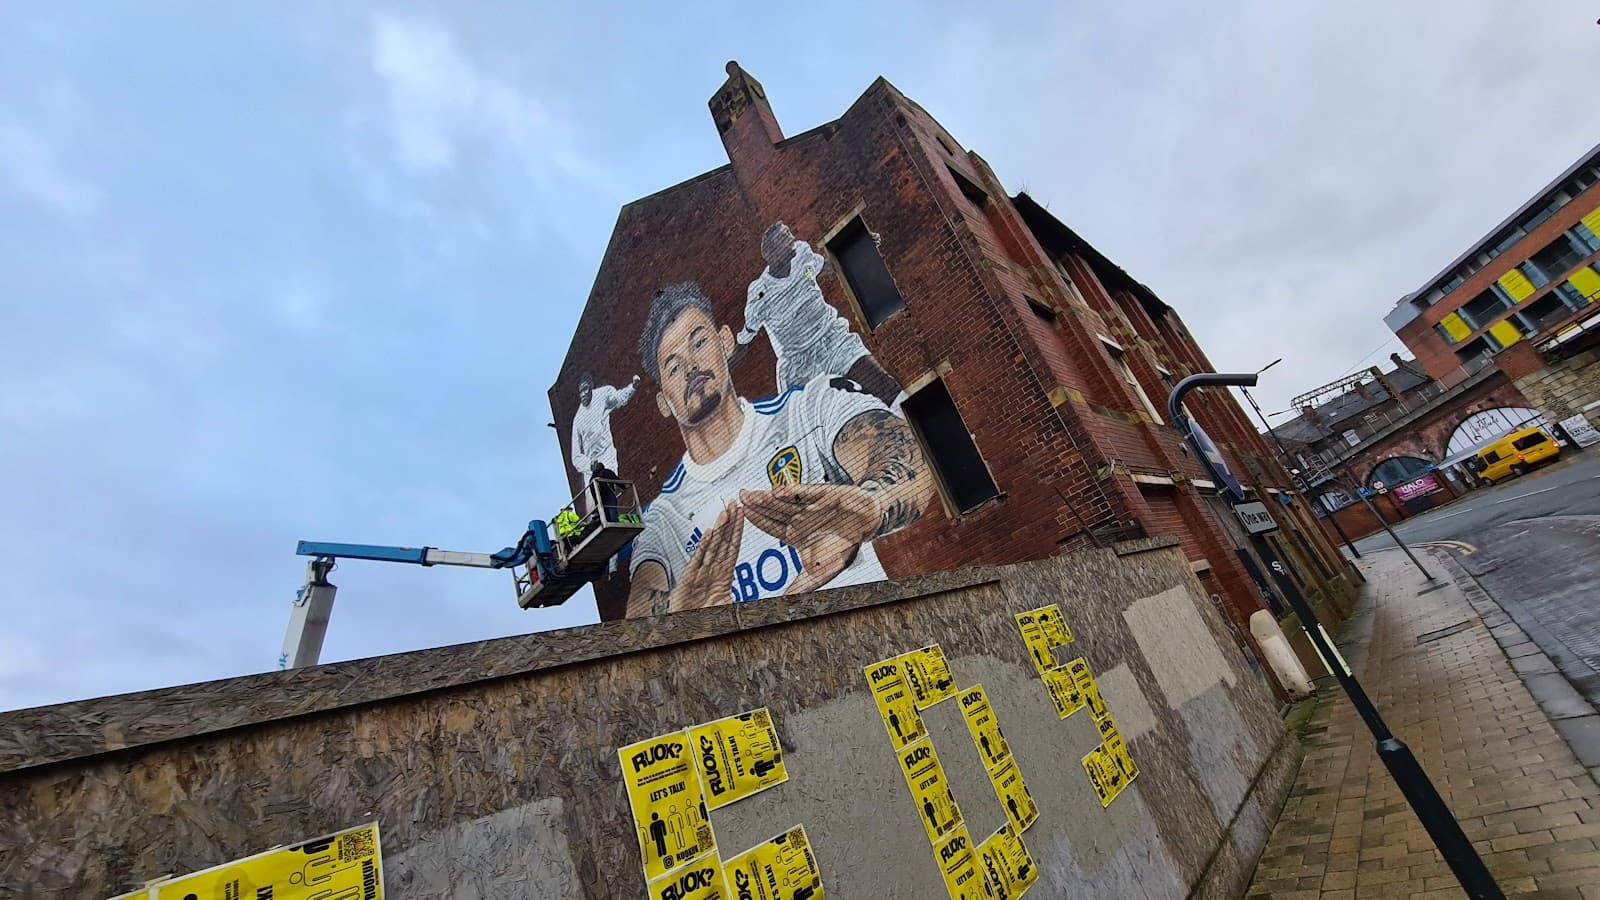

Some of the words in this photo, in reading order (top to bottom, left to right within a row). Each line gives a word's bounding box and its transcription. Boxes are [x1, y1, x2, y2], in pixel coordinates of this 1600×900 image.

[1241, 511, 1259, 526] One
[1256, 511, 1273, 524] way
[871, 665, 896, 684] RUOK?
[728, 735, 740, 756] TALK!
[632, 743, 683, 773] RUOK?
[700, 735, 726, 797] RUOK?
[734, 757, 745, 777] LET'S
[905, 747, 930, 770] RUOK?
[650, 788, 668, 802] LET'S
[668, 781, 686, 795] TALK!
[941, 836, 966, 864] RUOK?
